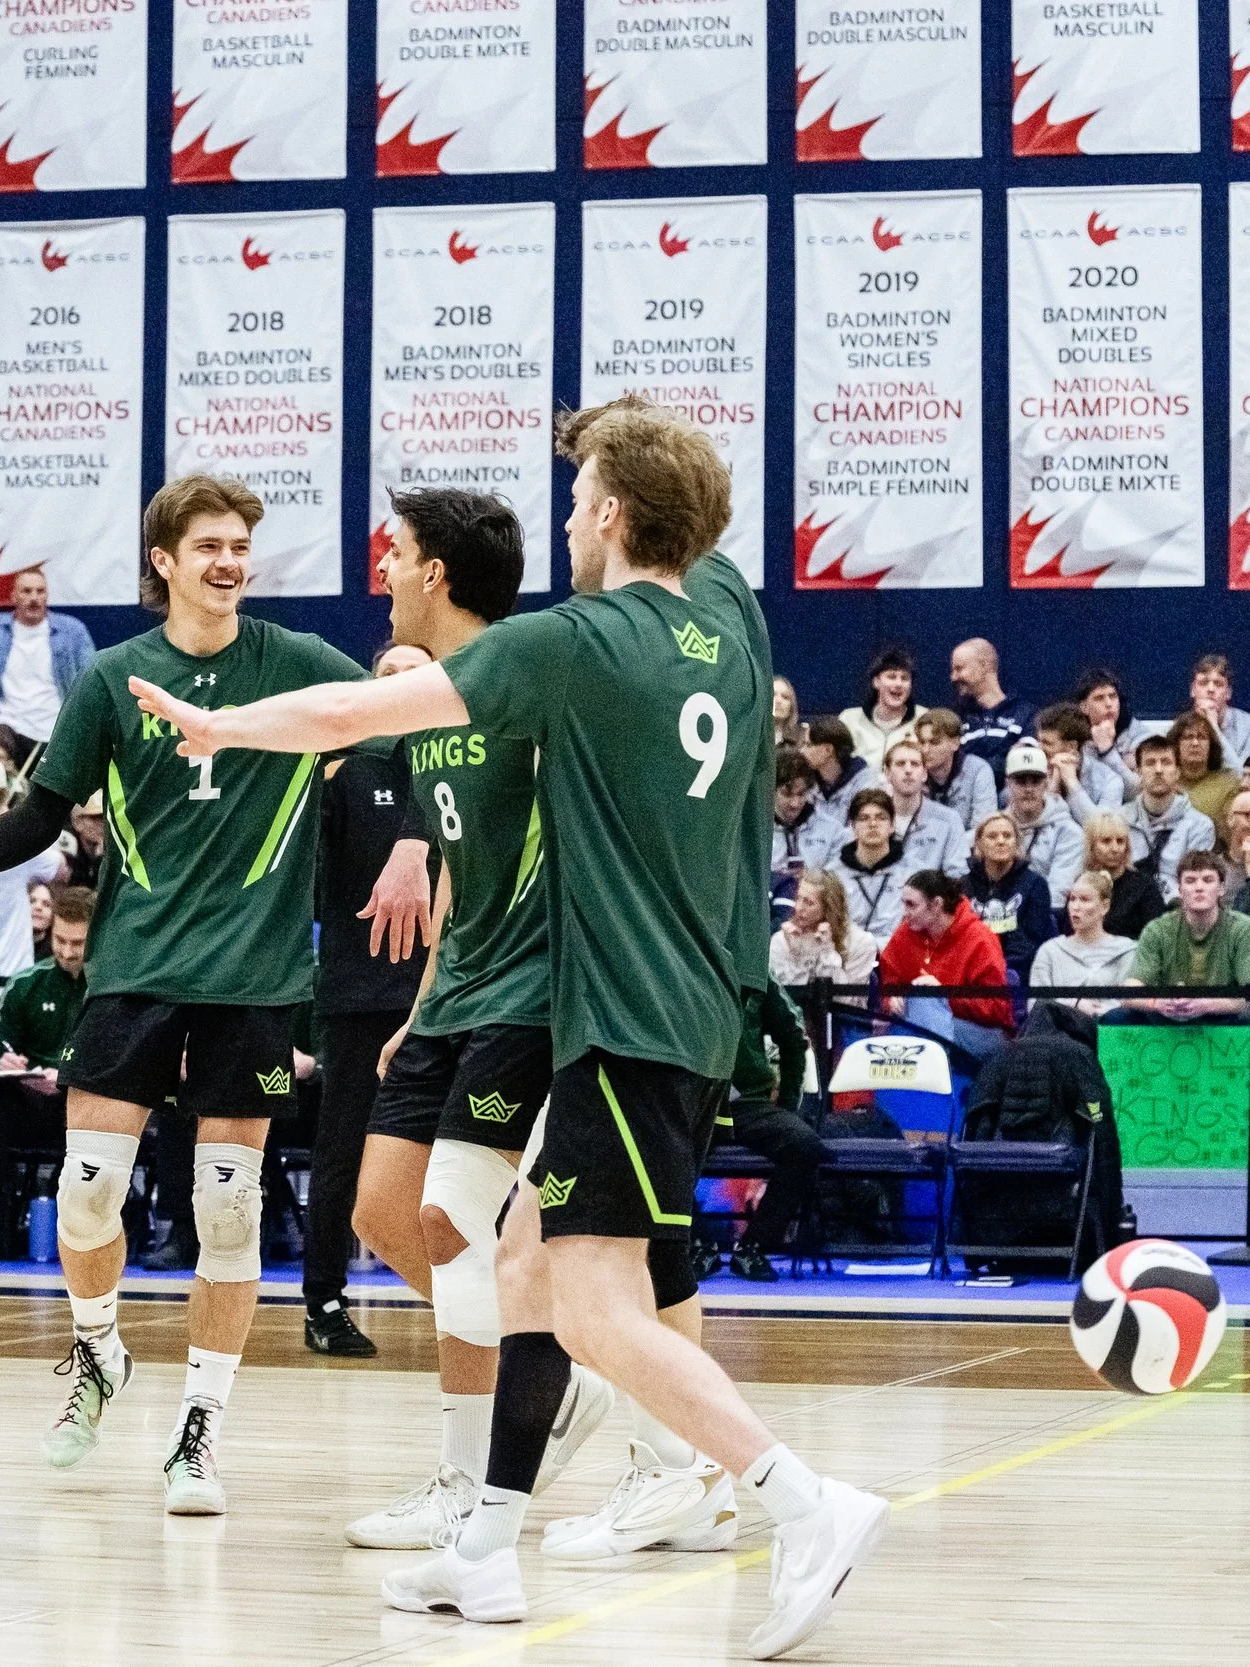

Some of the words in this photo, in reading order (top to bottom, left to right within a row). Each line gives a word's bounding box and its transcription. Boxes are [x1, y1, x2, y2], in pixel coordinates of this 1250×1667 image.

[206, 6, 311, 25] CANADIENS
[829, 7, 945, 27] BADMINTON
[1043, 1, 1164, 19] BASKETBALL
[9, 17, 112, 36] CANADIENS
[409, 25, 521, 42] BADMINTON
[617, 16, 731, 34] BADMINTON
[1054, 19, 1155, 37] MASCULIN
[202, 32, 313, 52] BASKETBALL
[595, 35, 660, 53] DOUBLE
[665, 33, 753, 51] MASCULIN
[807, 28, 874, 45] DOUBLE
[878, 25, 968, 42] MASCULIN
[23, 45, 99, 63] CURLING
[212, 51, 305, 69] MASCULIN
[399, 43, 471, 61] DOUBLE
[477, 41, 531, 57] MIXTE
[859, 271, 919, 293] 2019
[1068, 266, 1139, 288] 2020
[30, 306, 81, 326] 2016
[433, 305, 492, 327] 2018
[644, 298, 704, 321] 2019
[827, 309, 951, 328] BADMINTON
[1043, 305, 1167, 323] BADMINTON
[227, 311, 285, 333] 2018
[840, 330, 939, 348] WOMEN'S
[1071, 326, 1137, 343] MIXED
[26, 340, 83, 356] MEN'S
[402, 342, 522, 360] BADMINTON
[613, 336, 735, 355] BADMINTON
[1058, 346, 1152, 364] DOUBLES
[197, 348, 312, 367] BADMINTON
[594, 359, 656, 376] MEN'S
[662, 356, 754, 375] DOUBLES
[847, 351, 931, 369] SINGLES
[178, 370, 240, 387] MIXED
[244, 367, 332, 385] DOUBLES
[384, 365, 445, 381] MEN'S
[450, 362, 541, 380] DOUBLES
[8, 383, 97, 399] NATIONAL
[837, 381, 936, 399] NATIONAL
[1054, 376, 1155, 394] NATIONAL
[207, 395, 298, 412] NATIONAL
[413, 390, 509, 408] NATIONAL
[1020, 395, 1189, 418] CHAMPIONS
[381, 408, 542, 432] CHAMPIONS
[813, 399, 962, 423] CHAMPION
[0, 425, 106, 443] CANADIENS
[175, 412, 333, 437] CHAMPIONS
[1045, 425, 1165, 442] CANADIENS
[402, 437, 518, 455] CANADIENS
[829, 428, 947, 446] CANADIENS
[196, 440, 308, 458] CANADIENS
[827, 457, 950, 476] BADMINTON
[1043, 454, 1168, 471] BADMINTON
[5, 472, 100, 489] MASCULIN
[401, 467, 520, 484] BADMINTON
[1031, 476, 1114, 493] DOUBLE
[1119, 474, 1180, 491] MIXTE
[809, 480, 880, 496] SIMPLE
[886, 475, 969, 496] FÉMININ
[265, 489, 323, 506] MIXTE
[412, 734, 486, 775] KINGS
[679, 692, 728, 799] 9
[189, 755, 221, 800] 1
[434, 782, 462, 841] 8
[1139, 1040, 1201, 1080] GO
[1116, 1088, 1239, 1132] KINGS
